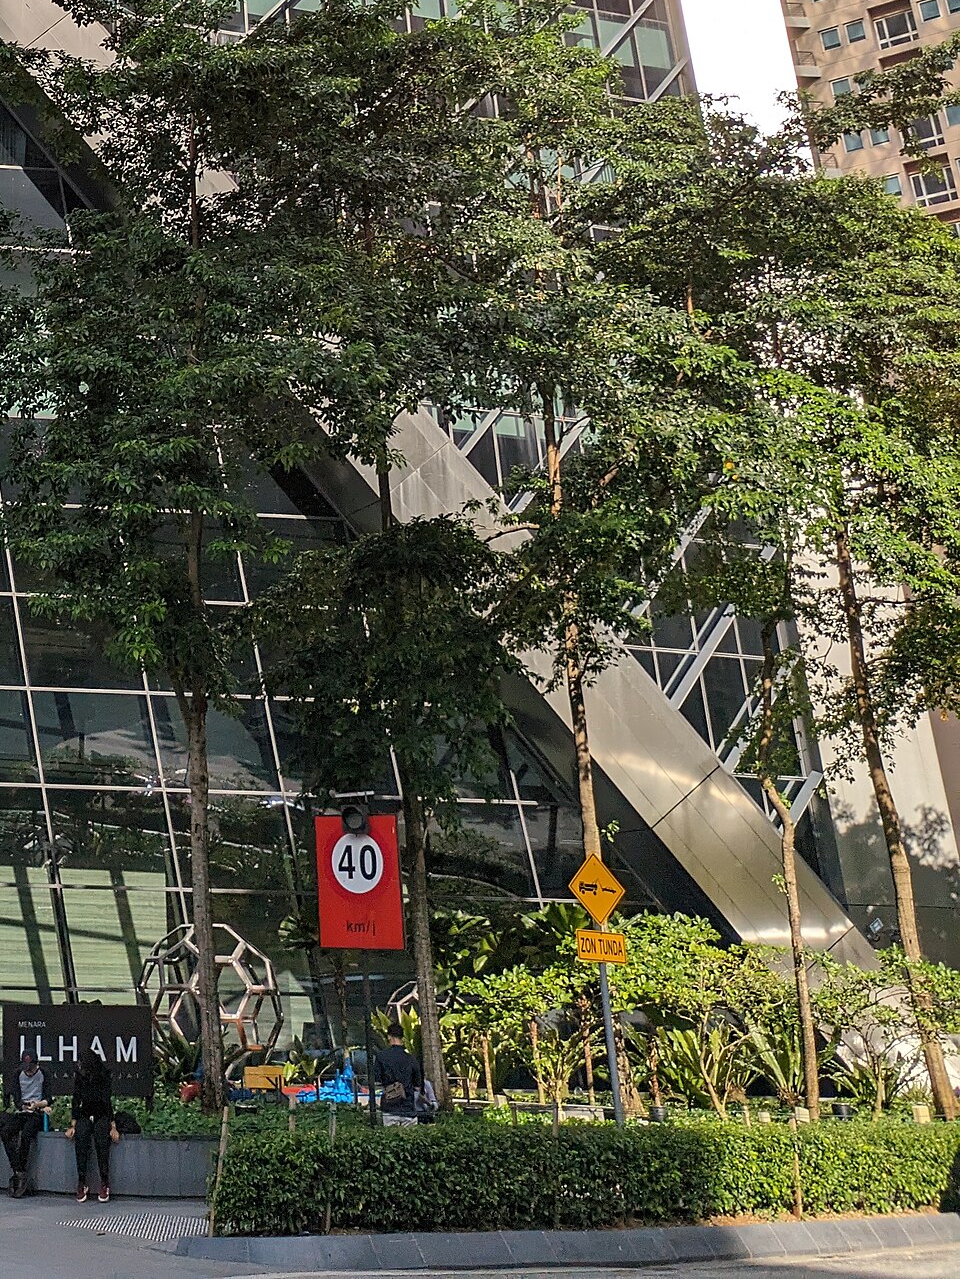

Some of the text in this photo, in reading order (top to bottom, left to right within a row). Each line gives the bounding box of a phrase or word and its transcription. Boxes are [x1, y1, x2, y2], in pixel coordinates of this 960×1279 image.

[338, 844, 378, 881] 40
[580, 937, 624, 956] ZON TUNDA
[19, 1034, 137, 1063] ILHAM
